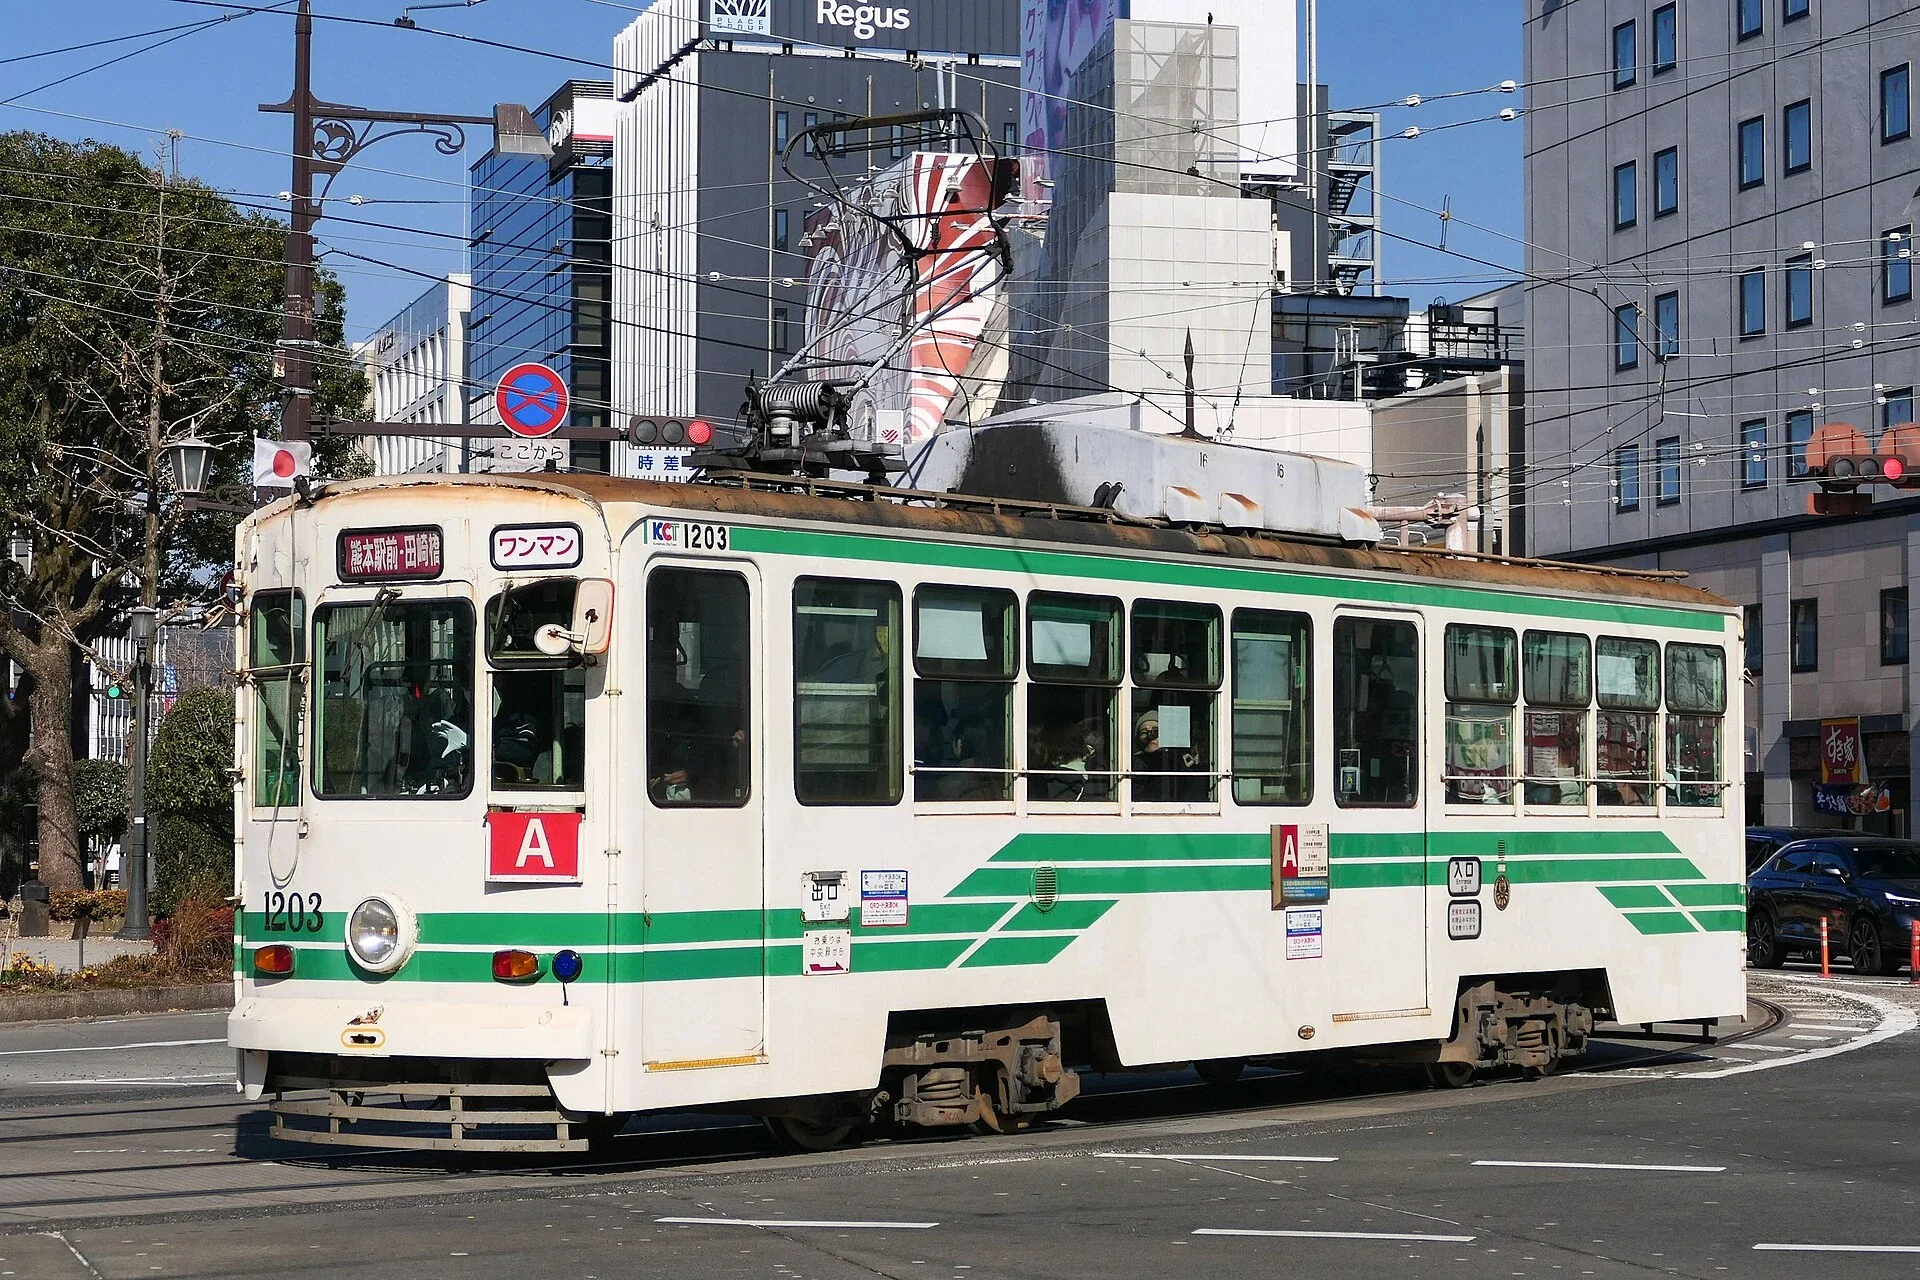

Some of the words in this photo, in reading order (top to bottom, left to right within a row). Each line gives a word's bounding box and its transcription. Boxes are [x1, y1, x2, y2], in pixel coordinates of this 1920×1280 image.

[716, 17, 764, 25] PLACE
[816, 0, 910, 39] Regus
[499, 444, 564, 461] ここから
[638, 455, 697, 471] 時差
[500, 536, 574, 558] ワンマン
[652, 521, 680, 541] KCT
[684, 523, 727, 550] 1203
[1826, 725, 1855, 767] すき家
[514, 818, 555, 868] A
[1282, 834, 1298, 868] A
[1454, 862, 1474, 878] 入口
[812, 883, 838, 901] 出口
[264, 891, 324, 932] 1203
